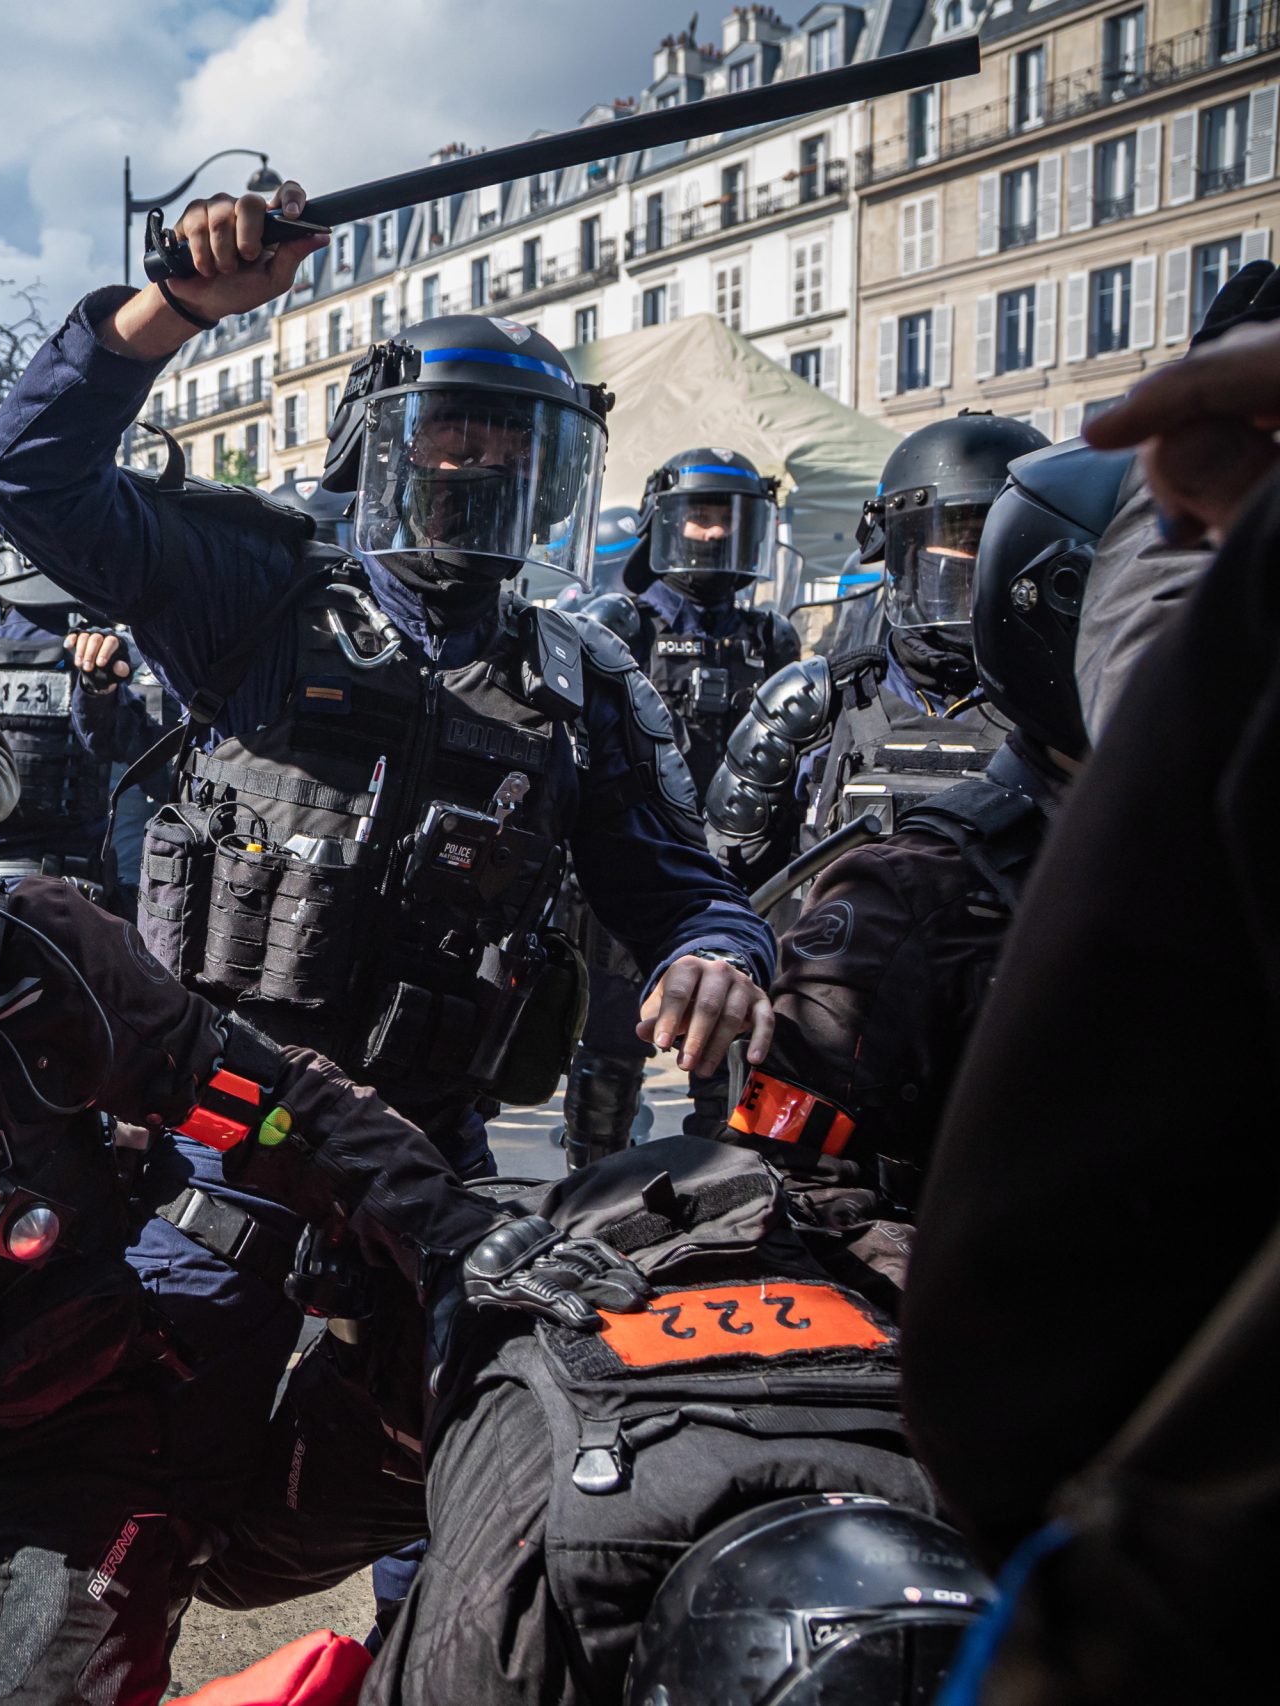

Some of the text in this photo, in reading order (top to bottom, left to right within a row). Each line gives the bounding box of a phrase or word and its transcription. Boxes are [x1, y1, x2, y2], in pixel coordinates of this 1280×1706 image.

[656, 641, 702, 655] POLICE
[2, 682, 49, 703] 123
[447, 718, 540, 764] POLICE
[438, 851, 472, 865] NATIONALE
[443, 842, 472, 858] POLICE
[87, 1518, 140, 1601] BERING
